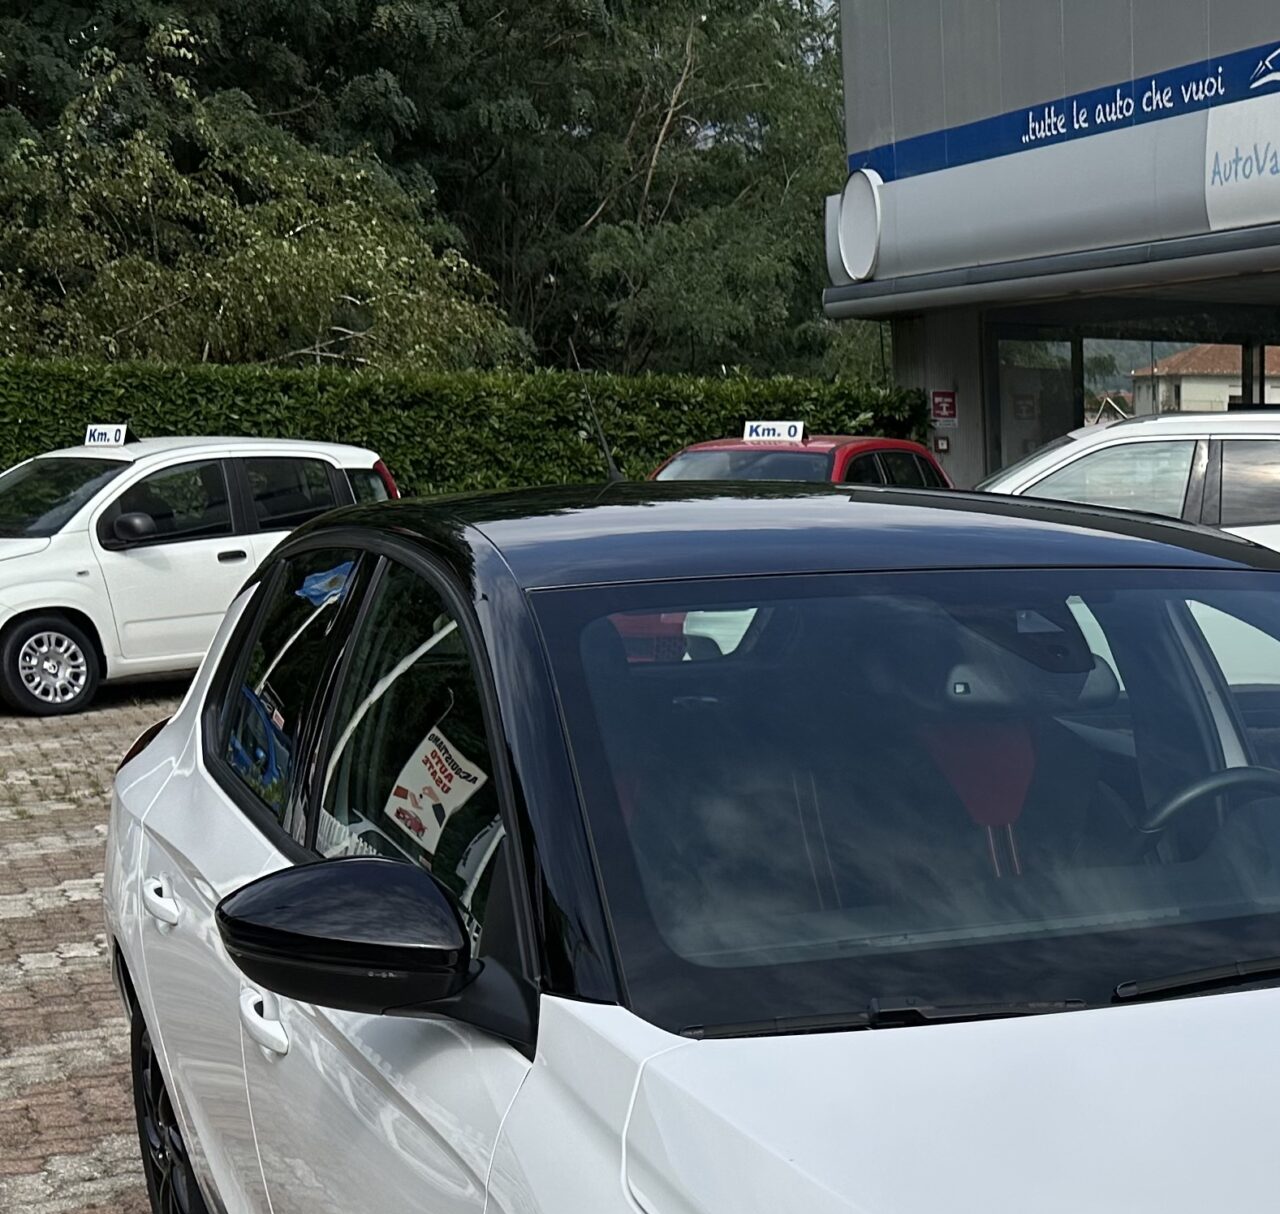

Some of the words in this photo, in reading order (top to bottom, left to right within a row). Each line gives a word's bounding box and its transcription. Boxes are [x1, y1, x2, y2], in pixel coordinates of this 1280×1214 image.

[1073, 100, 1089, 130] le
[1095, 88, 1135, 125] auto
[1141, 79, 1174, 112] che
[1181, 65, 1225, 104] vuoi
[88, 428, 110, 443] Km.
[114, 428, 122, 443] 0
[749, 424, 782, 438] Km.
[787, 424, 798, 438] 0
